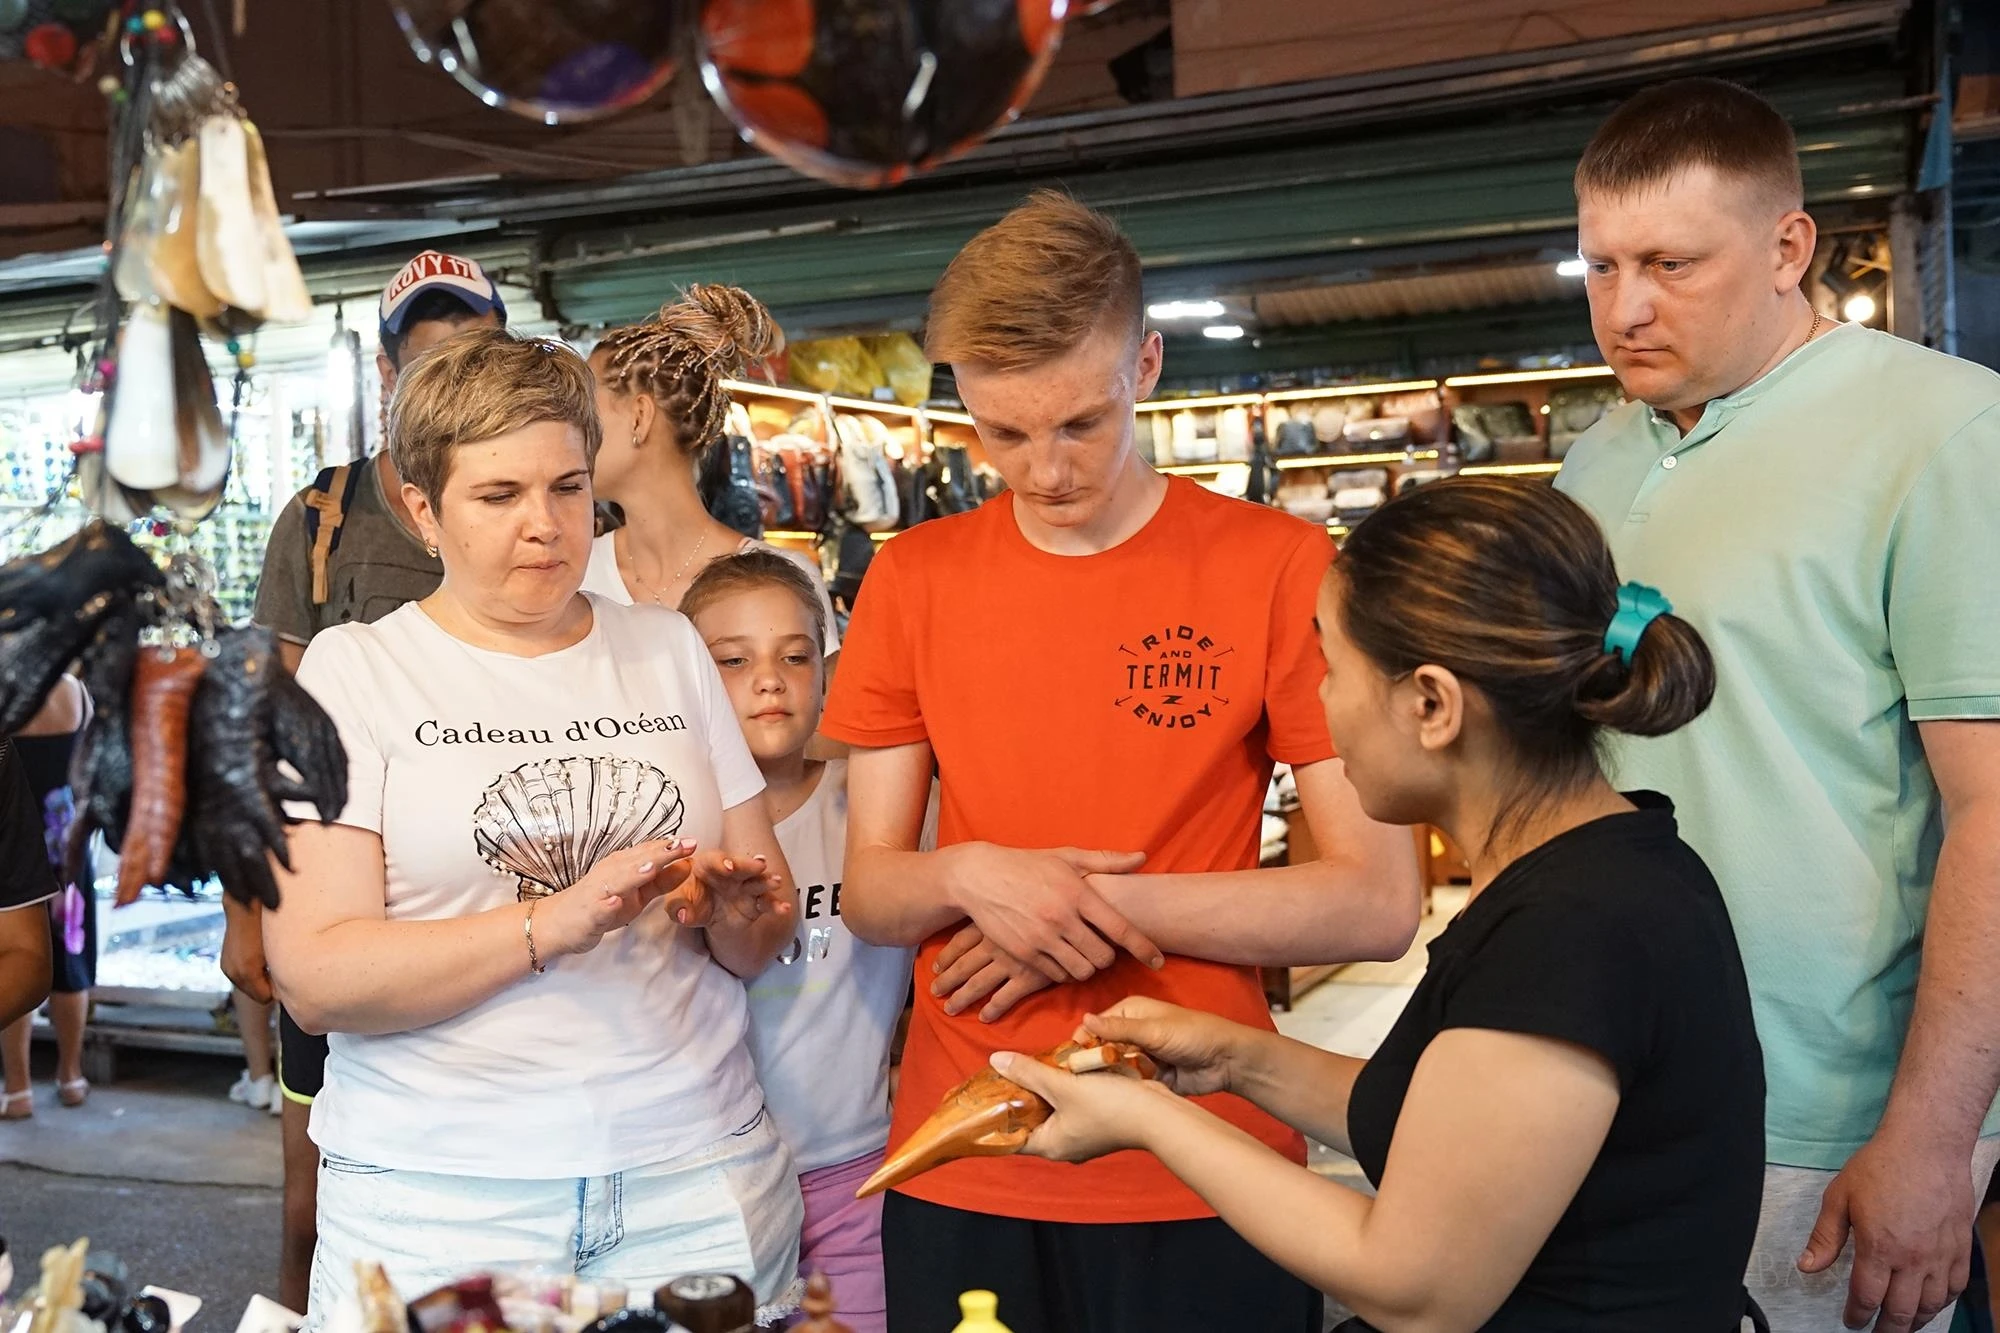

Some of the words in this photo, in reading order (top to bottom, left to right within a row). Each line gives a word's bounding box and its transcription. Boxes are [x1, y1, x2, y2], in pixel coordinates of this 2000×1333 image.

[1141, 625, 1214, 651] RIDE
[1160, 650, 1192, 659] AND
[1127, 663, 1221, 690] TERMIT
[1133, 703, 1212, 728] ENJOY
[414, 719, 554, 746] Cadeau
[565, 712, 688, 741] d'Océan
